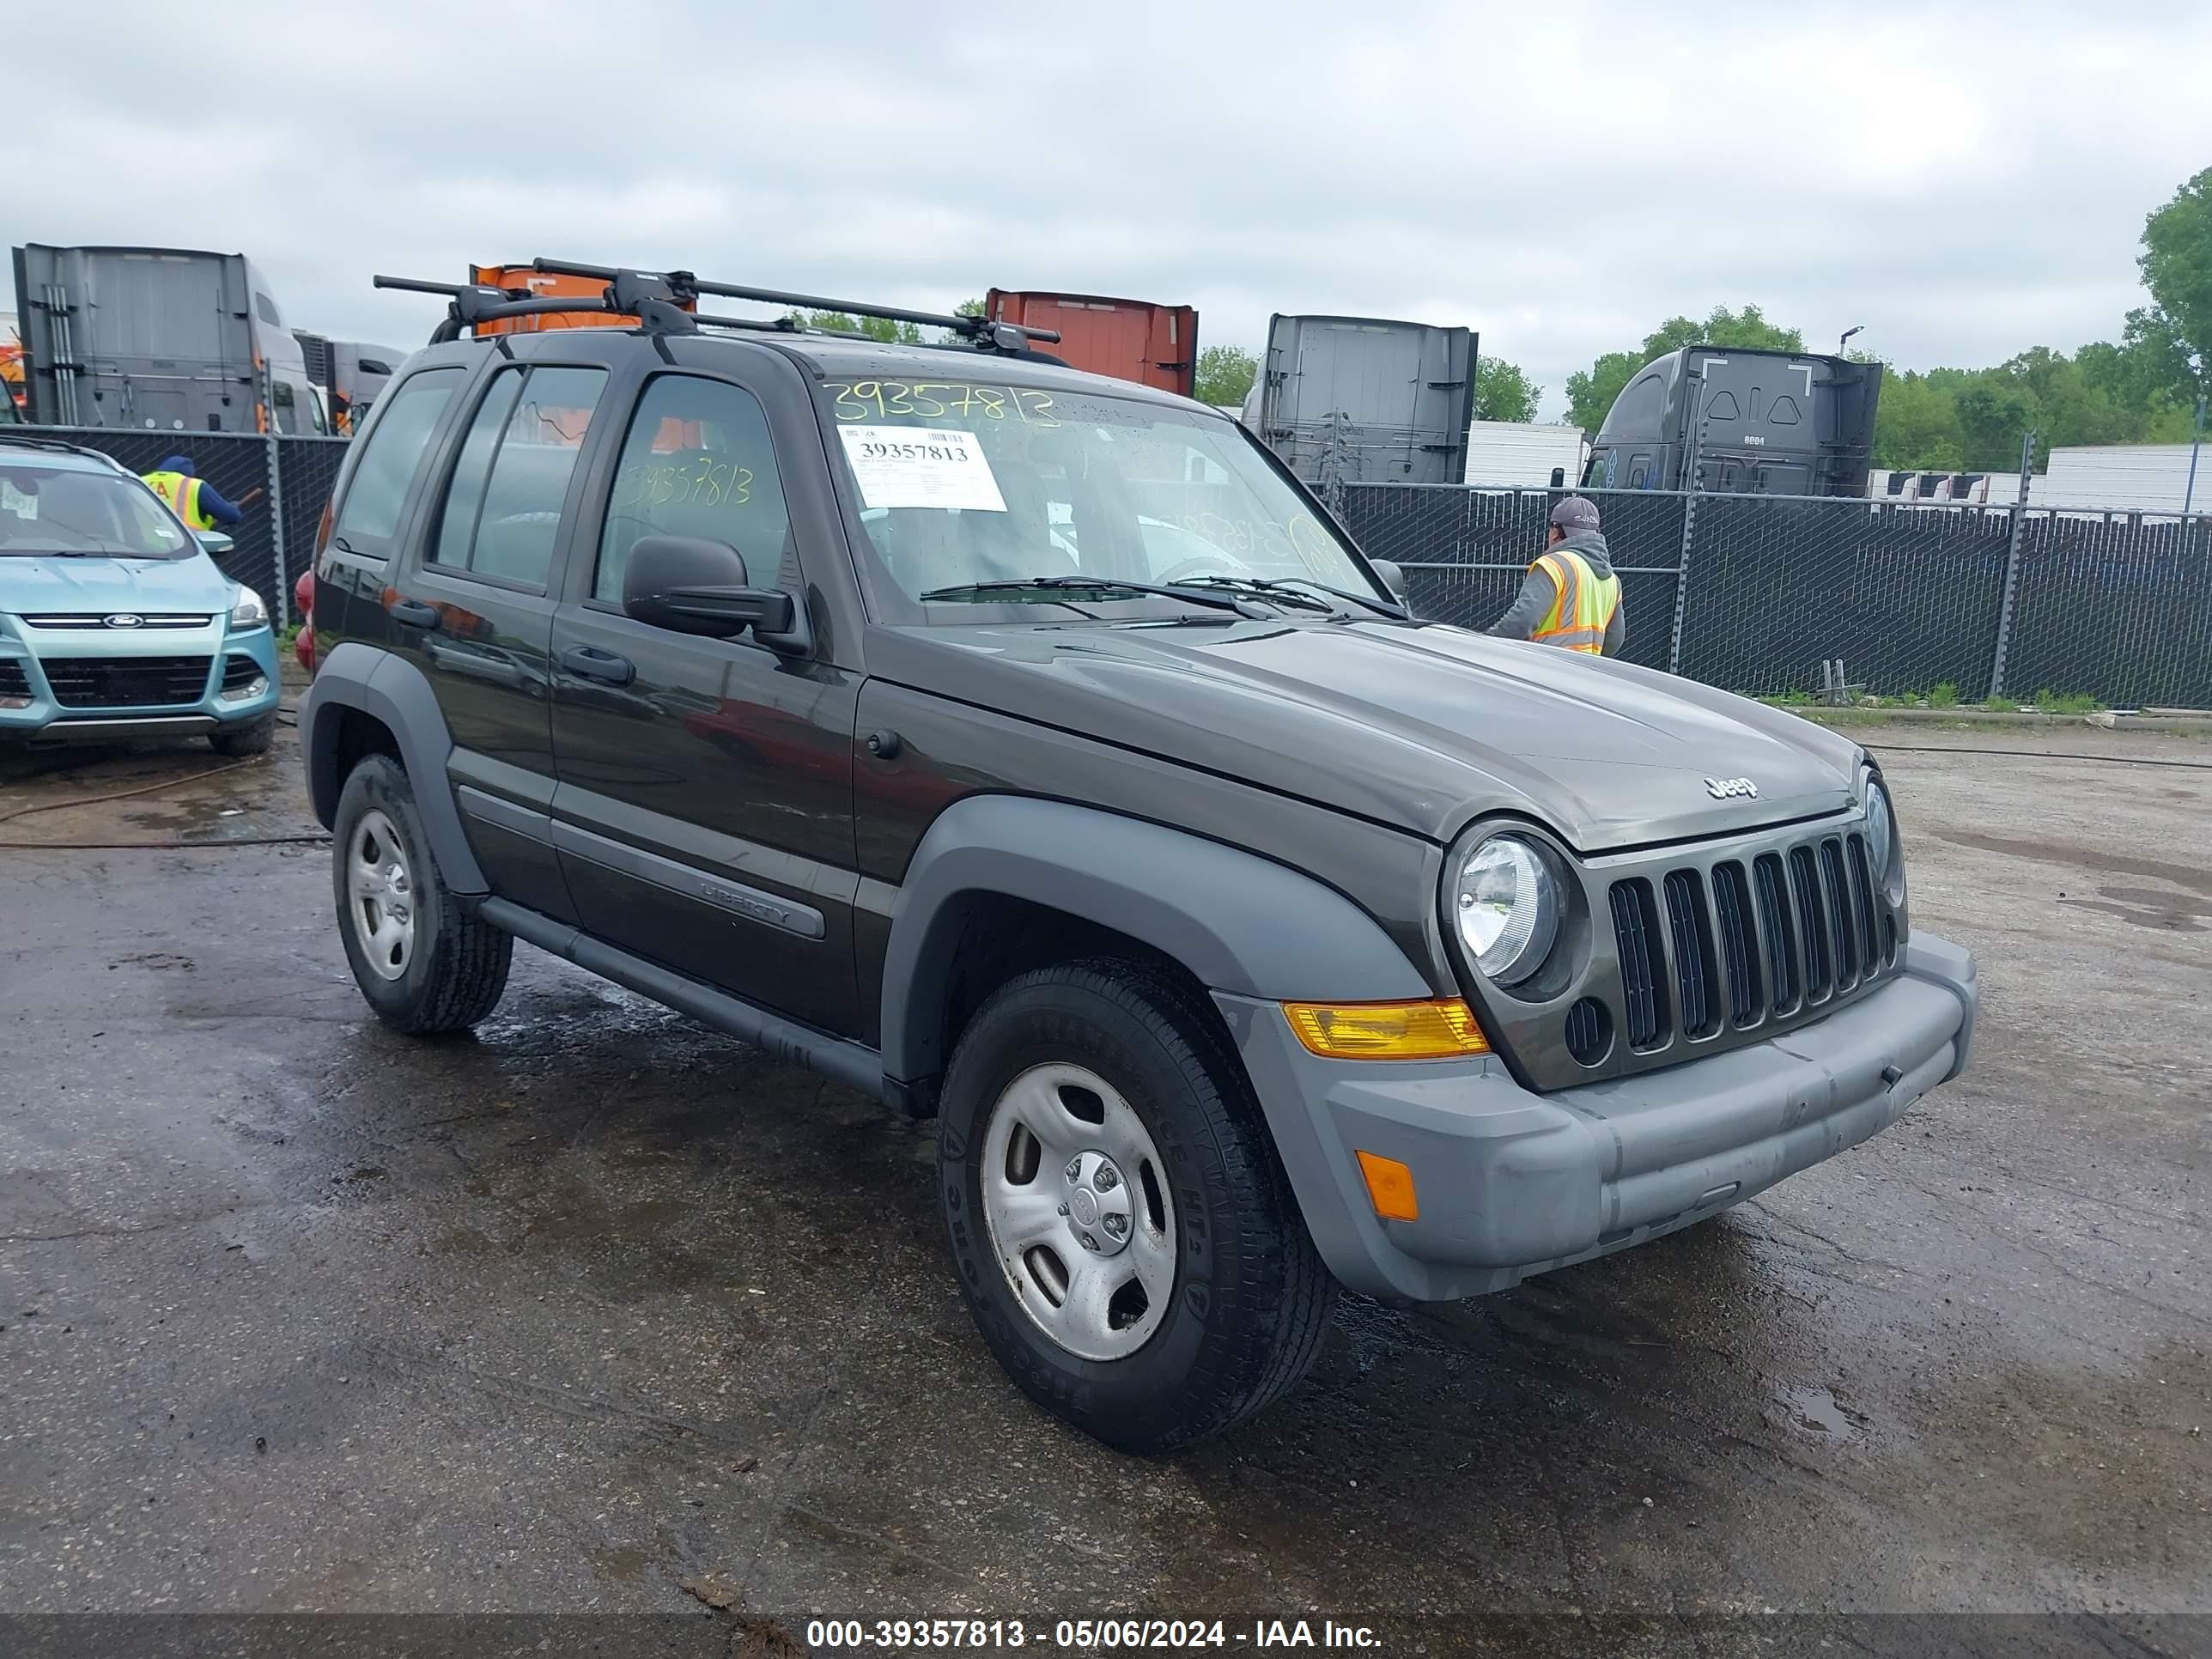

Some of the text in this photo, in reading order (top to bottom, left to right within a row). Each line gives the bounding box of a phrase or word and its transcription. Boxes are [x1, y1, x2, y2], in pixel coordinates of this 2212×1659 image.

[823, 381, 1061, 428] 39357813
[860, 442, 969, 463] 39357813
[620, 458, 754, 507] 39357813
[1703, 777, 1758, 799] Jeep
[700, 883, 790, 924] LIBERTY
